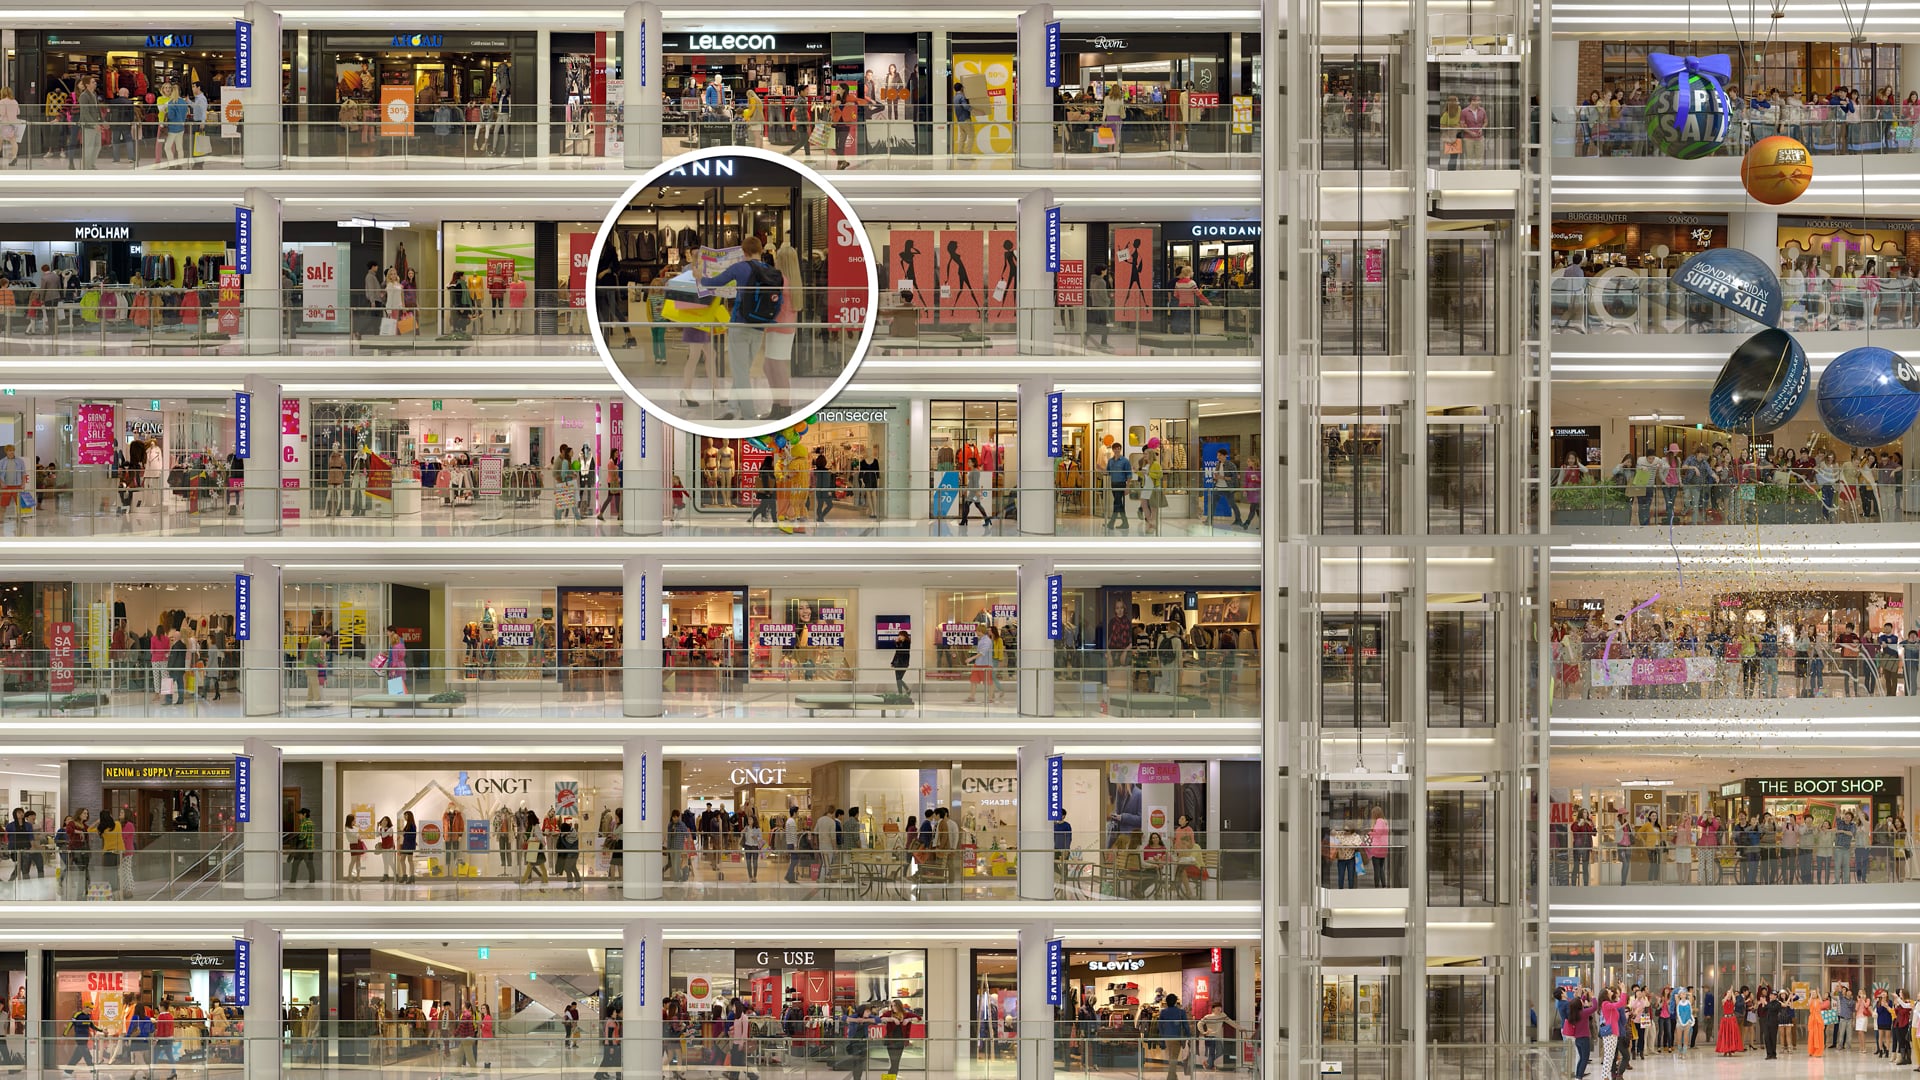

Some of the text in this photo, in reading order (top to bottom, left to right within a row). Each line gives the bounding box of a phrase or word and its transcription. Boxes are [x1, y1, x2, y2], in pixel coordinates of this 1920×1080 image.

[1190, 97, 1219, 106] SALE
[1568, 212, 1628, 222] BURGERHUNTER
[75, 224, 129, 239] MPÖLHAM
[573, 253, 589, 268] SA
[1059, 263, 1083, 274] SALE
[1694, 262, 1739, 286] MONDAY
[220, 278, 240, 287] UP TO
[1684, 271, 1730, 299] SUPER
[1058, 292, 1083, 303] SALE
[1732, 292, 1768, 317] SALE
[88, 413, 107, 422] GRAND
[88, 430, 106, 439] SALE
[502, 624, 532, 632] GRAND
[763, 624, 794, 632] GRAND
[811, 624, 842, 632] GRAND
[946, 623, 976, 632] GRAND
[54, 637, 72, 647] SA
[502, 637, 530, 646] SALE
[763, 637, 792, 646] SALE
[811, 637, 841, 646] SALE
[946, 636, 975, 646] SALE
[55, 647, 71, 656] LE
[106, 768, 134, 777] NENIM
[142, 768, 173, 777] SUPPLY
[730, 768, 787, 785] GNGT
[474, 778, 533, 795] GNGT
[962, 777, 1018, 793] GNGT
[1758, 781, 1789, 793] THE
[1794, 780, 1838, 793] BOOT
[239, 944, 247, 1002] SAMSUNG
[87, 973, 123, 990] SALE
